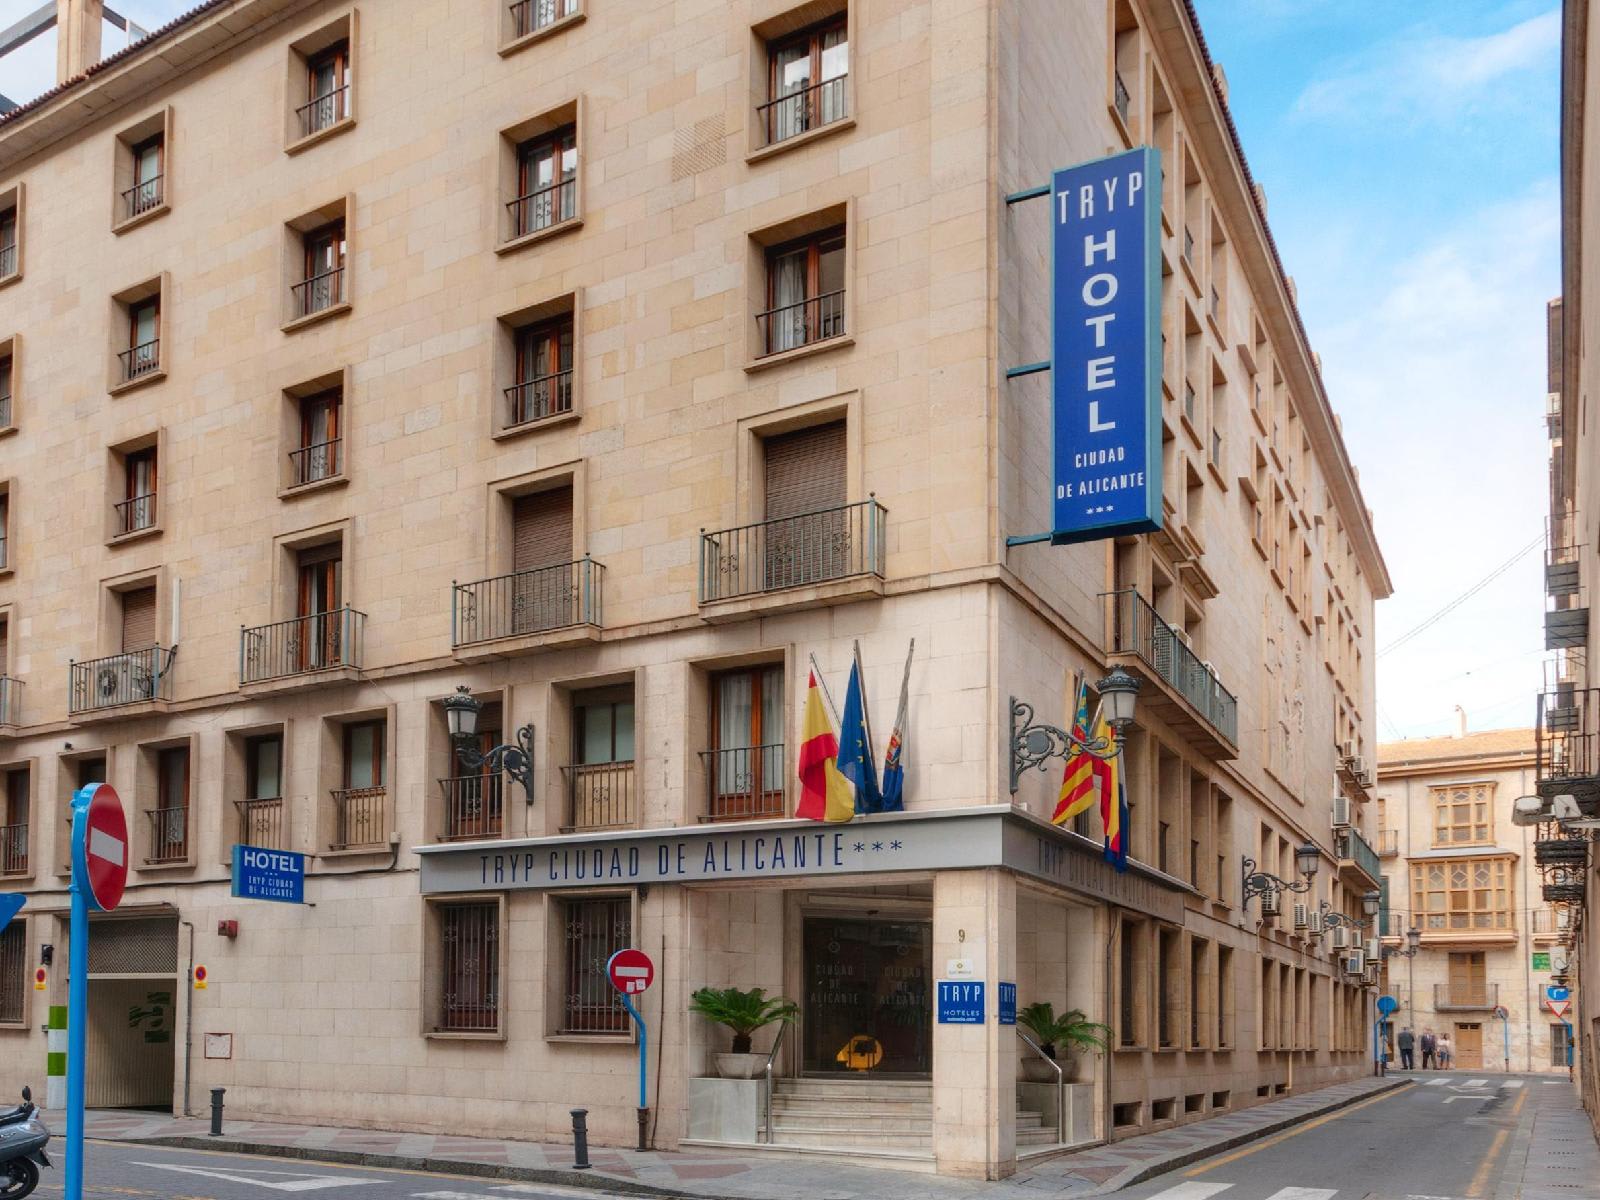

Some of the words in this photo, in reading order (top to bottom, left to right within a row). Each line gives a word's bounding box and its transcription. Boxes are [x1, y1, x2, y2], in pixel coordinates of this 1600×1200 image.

[1057, 171, 1143, 225] TRYP
[1081, 229, 1119, 433] HOTEL
[1075, 446, 1125, 468] CIUDAD
[1057, 483, 1073, 499] DE
[1079, 472, 1145, 496] ALICANTE
[244, 850, 299, 873] HOTEL
[480, 853, 534, 884] TRYP
[550, 847, 640, 880] CIUDAD
[658, 843, 686, 876] DE
[703, 833, 844, 873] ALICANTE
[1038, 838, 1064, 878] TRYP
[268, 878, 294, 889] CIUDAD
[958, 929, 966, 943] 9
[942, 985, 981, 1002] TRYP
[943, 1009, 980, 1017] HOTELES
